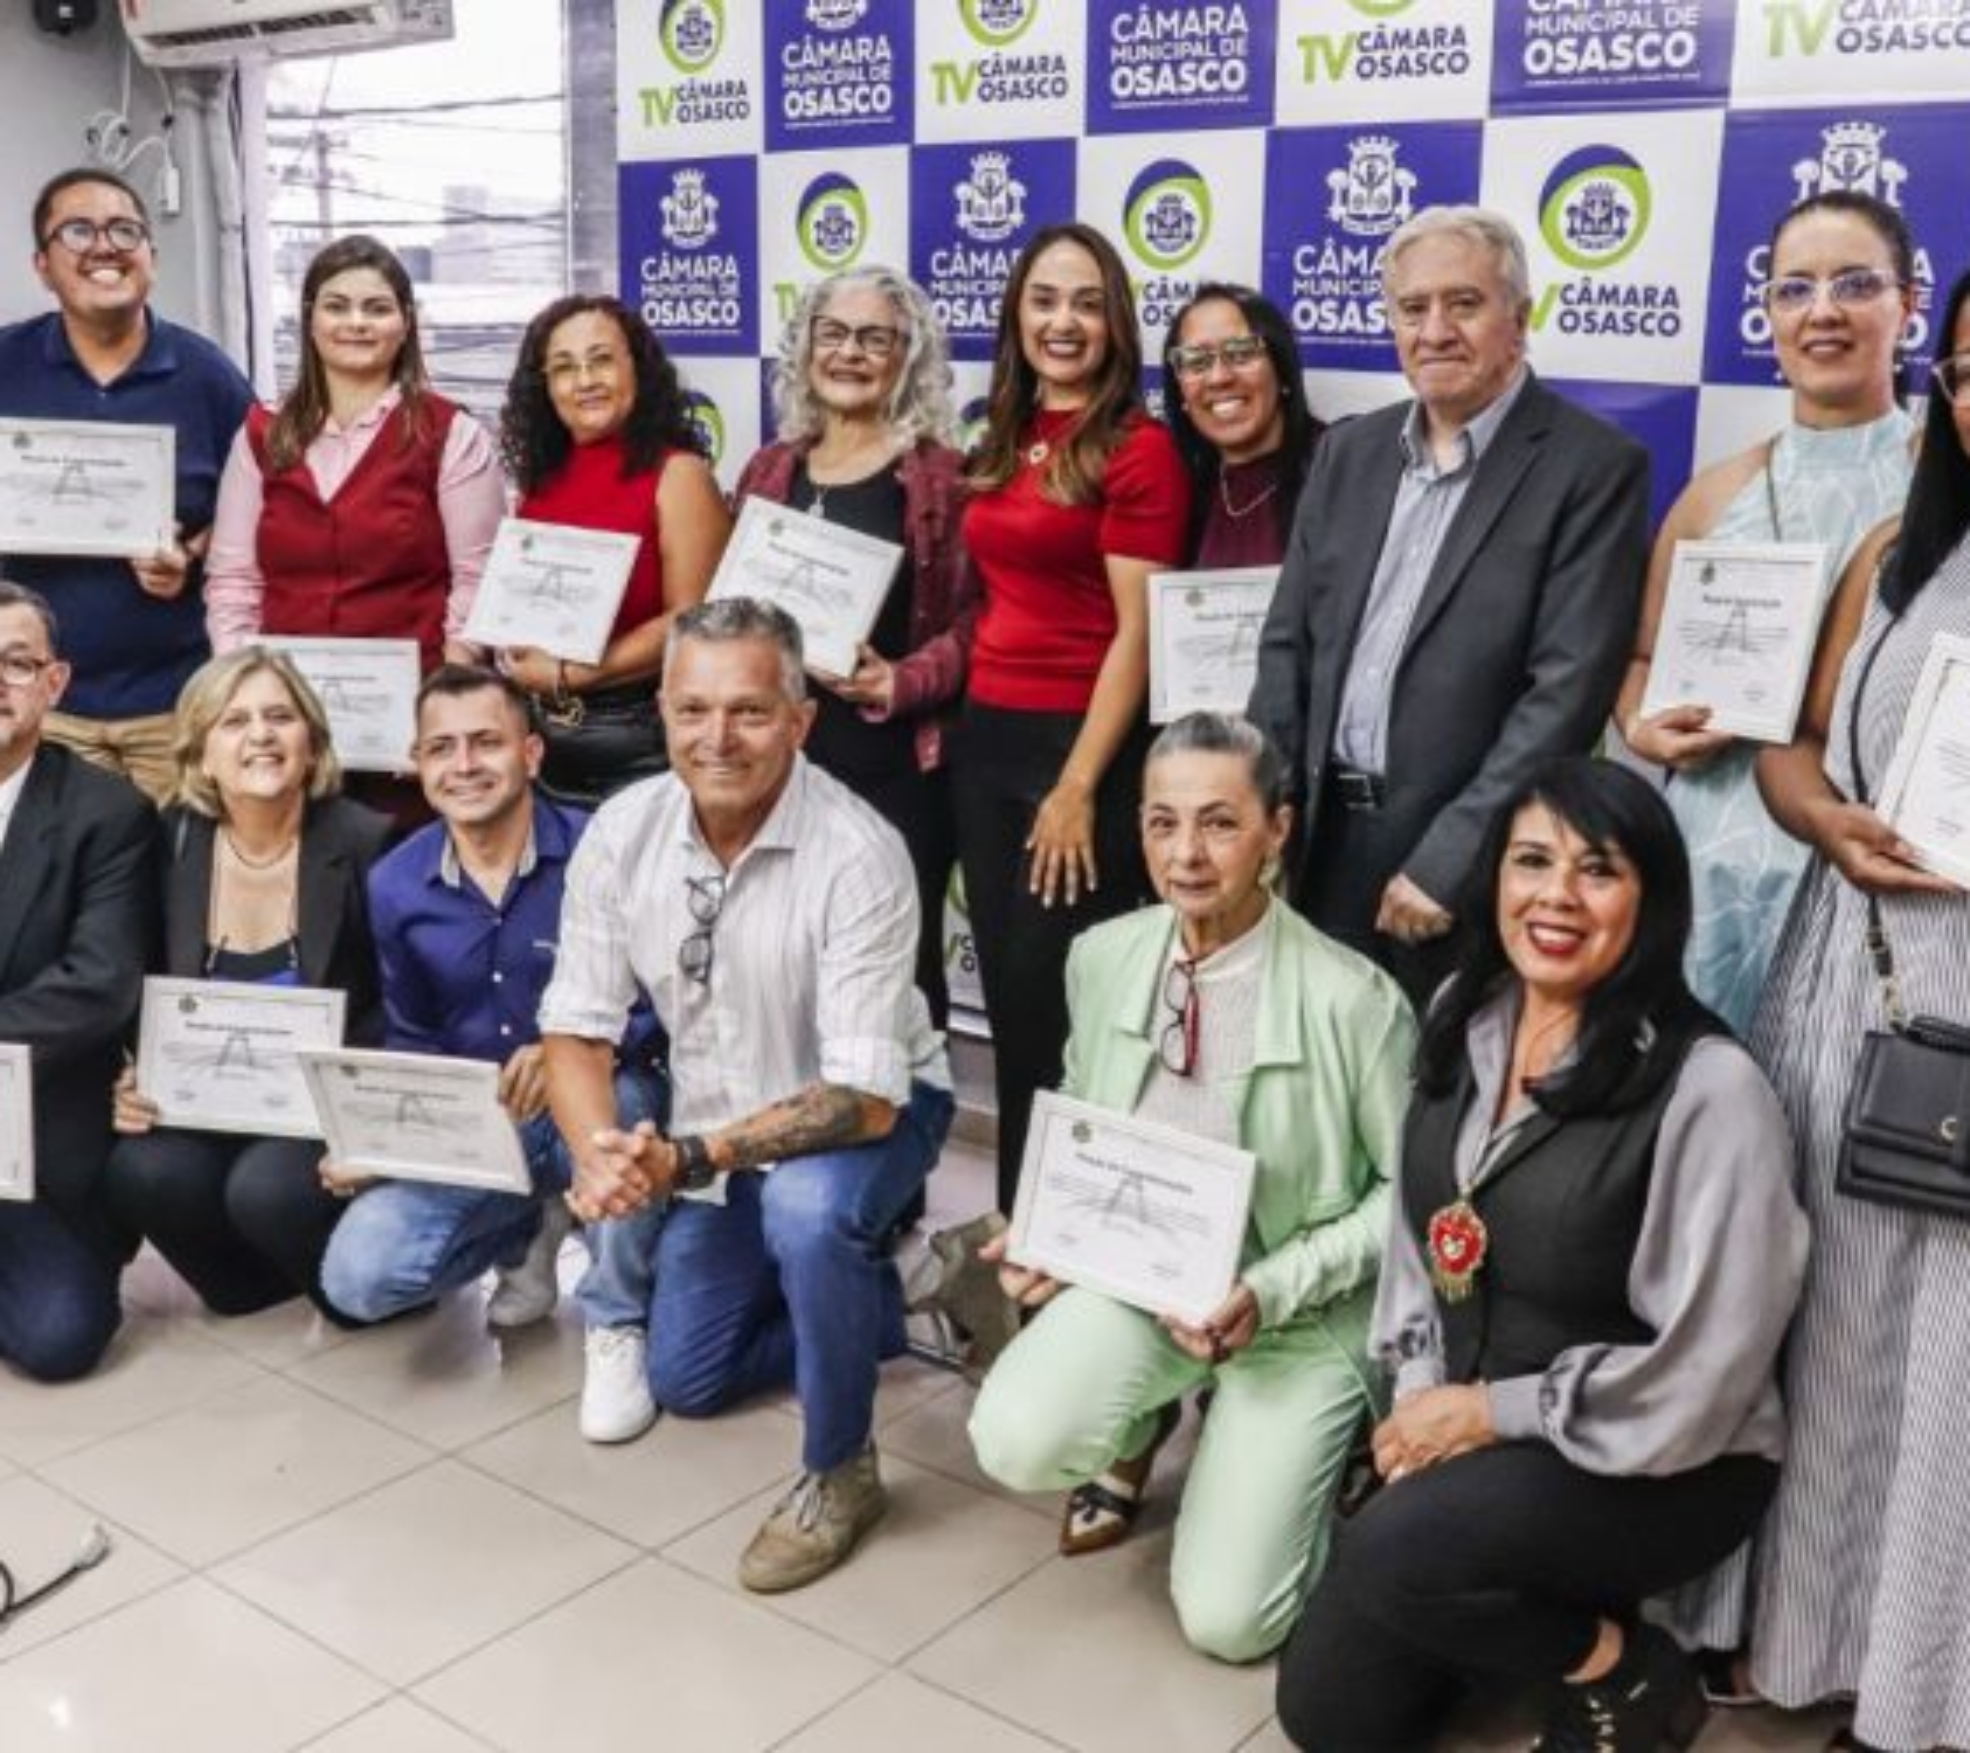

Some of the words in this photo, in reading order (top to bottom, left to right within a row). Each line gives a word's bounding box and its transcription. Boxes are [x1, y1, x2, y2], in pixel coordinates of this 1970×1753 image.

[1111, 3, 1249, 43] CÂMARA
[1525, 9, 1658, 37] MUNICIPAL
[1664, 6, 1699, 29] DE
[782, 34, 891, 69] CÂMARA
[1110, 41, 1217, 65] MUNICIPAL
[1220, 37, 1248, 57] DE
[1298, 32, 1356, 84] TV
[1356, 23, 1467, 52] CÂMARA
[1355, 50, 1470, 80] OSASCO
[1523, 30, 1698, 75] OSASCO
[931, 60, 980, 106] TV
[978, 52, 1067, 78] CÂMARA
[977, 76, 1069, 102] OSASCO
[1110, 58, 1247, 98] OSASCO
[638, 84, 674, 127] TV
[675, 76, 748, 103] CÂMARA
[676, 100, 750, 124] OSASCO
[784, 84, 892, 119] OSASCO
[641, 252, 740, 281] CÂMARA
[931, 242, 1020, 278] CÂMA
[1293, 238, 1386, 276] CÂMA
[1559, 276, 1680, 310] CÂMARA
[641, 300, 740, 328] OSASCO
[932, 299, 1004, 328] OSAS
[1292, 299, 1388, 334] OSAS
[1558, 308, 1680, 338] OSASCO
